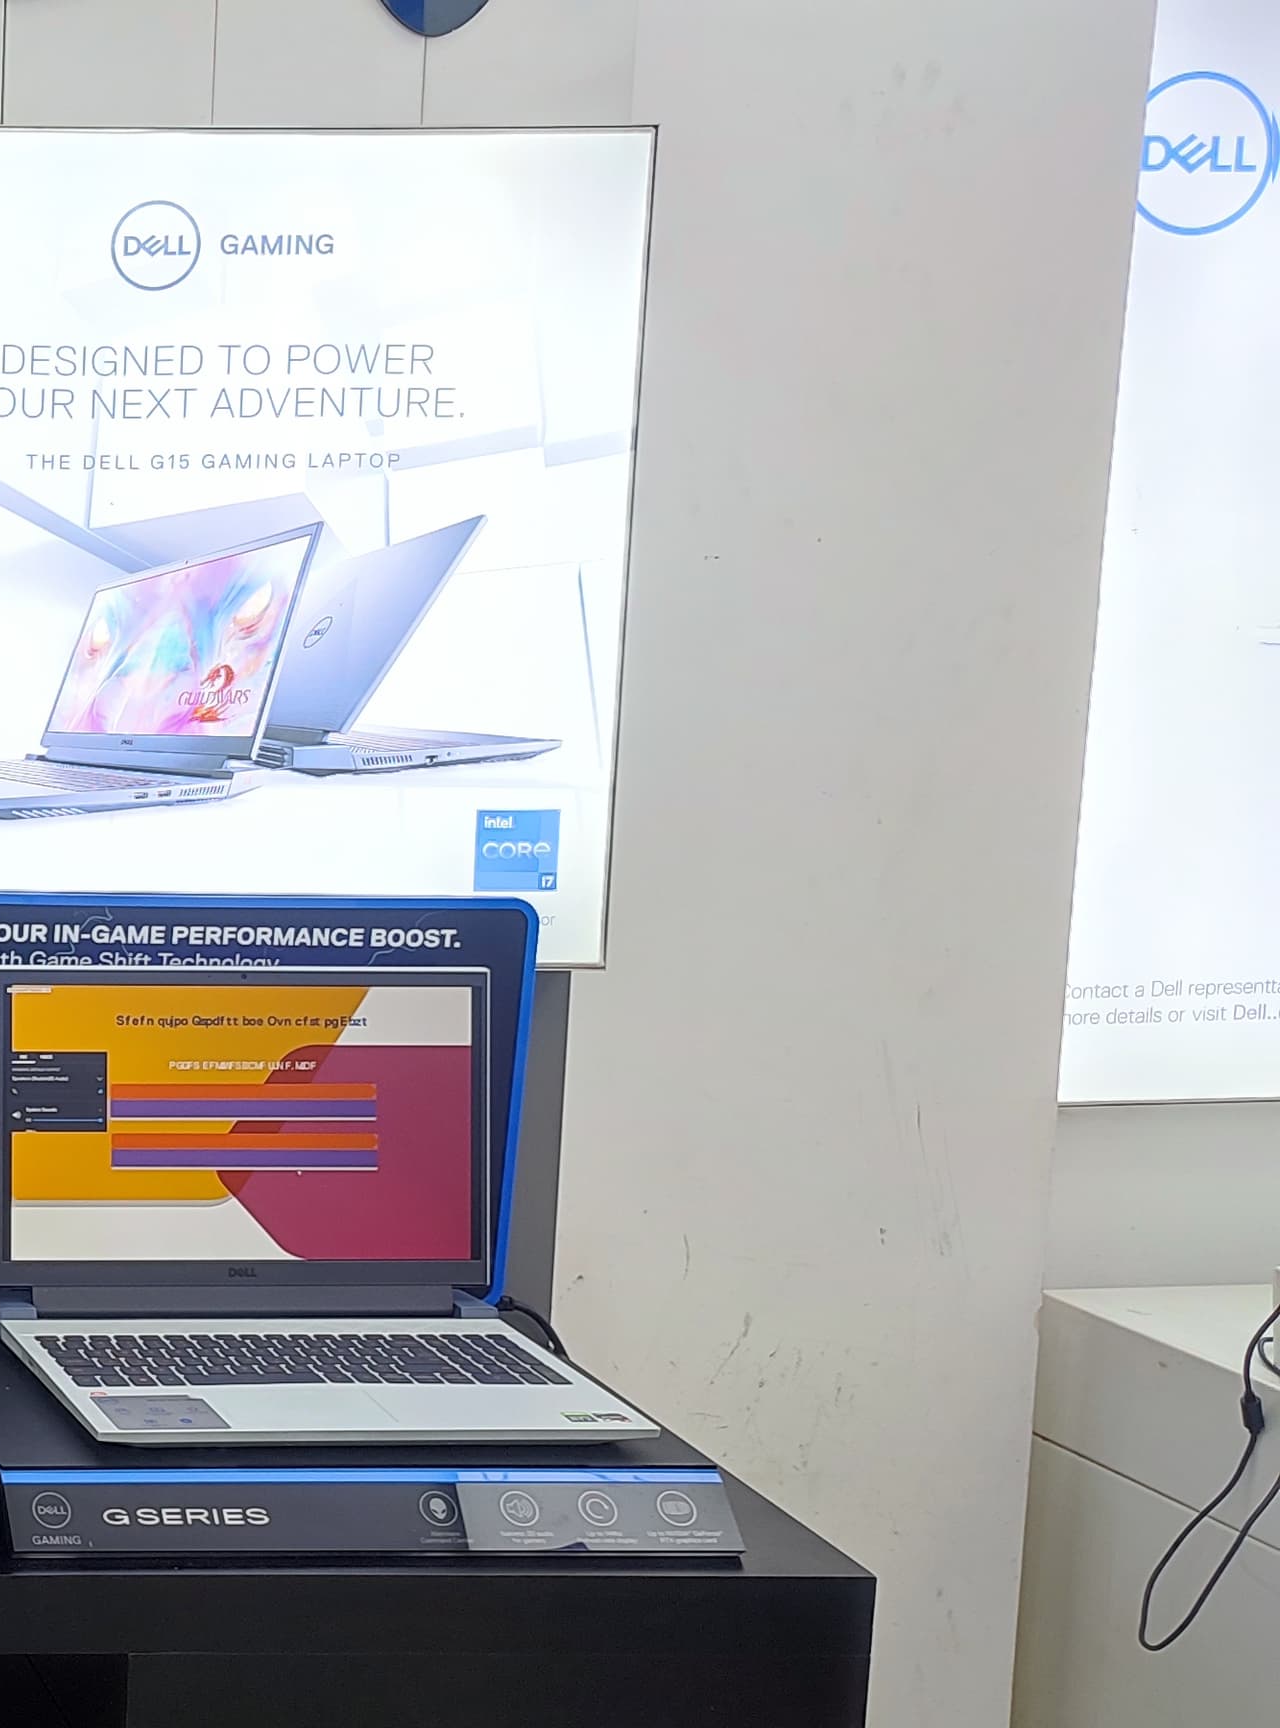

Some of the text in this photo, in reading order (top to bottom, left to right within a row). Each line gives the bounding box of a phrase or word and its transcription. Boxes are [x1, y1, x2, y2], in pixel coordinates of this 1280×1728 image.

[1141, 134, 1257, 174] DELL
[124, 233, 335, 257] DELL GAMING
[1, 343, 435, 377] DESIGNED TO POWER
[90, 386, 198, 420] NEXT
[210, 386, 466, 420] ADVENTURE.
[26, 452, 402, 471] THE DELL G15 GAMING LAPTOP
[483, 815, 513, 829] intel
[541, 876, 555, 889] i7
[53, 924, 166, 945] IN-GAME
[172, 925, 365, 948] PERFORMANCE
[370, 928, 462, 949] BOOST.
[29, 951, 92, 967] Game
[98, 952, 152, 967] Shift
[1134, 986, 1145, 997] a
[1151, 979, 1183, 997] Dell
[1105, 1008, 1163, 1025] details
[1168, 1010, 1185, 1023] or
[1192, 1006, 1227, 1022] visit
[37, 1504, 68, 1516] DELL
[102, 1507, 271, 1526] G SERIES
[31, 1534, 82, 1546] GAMING
